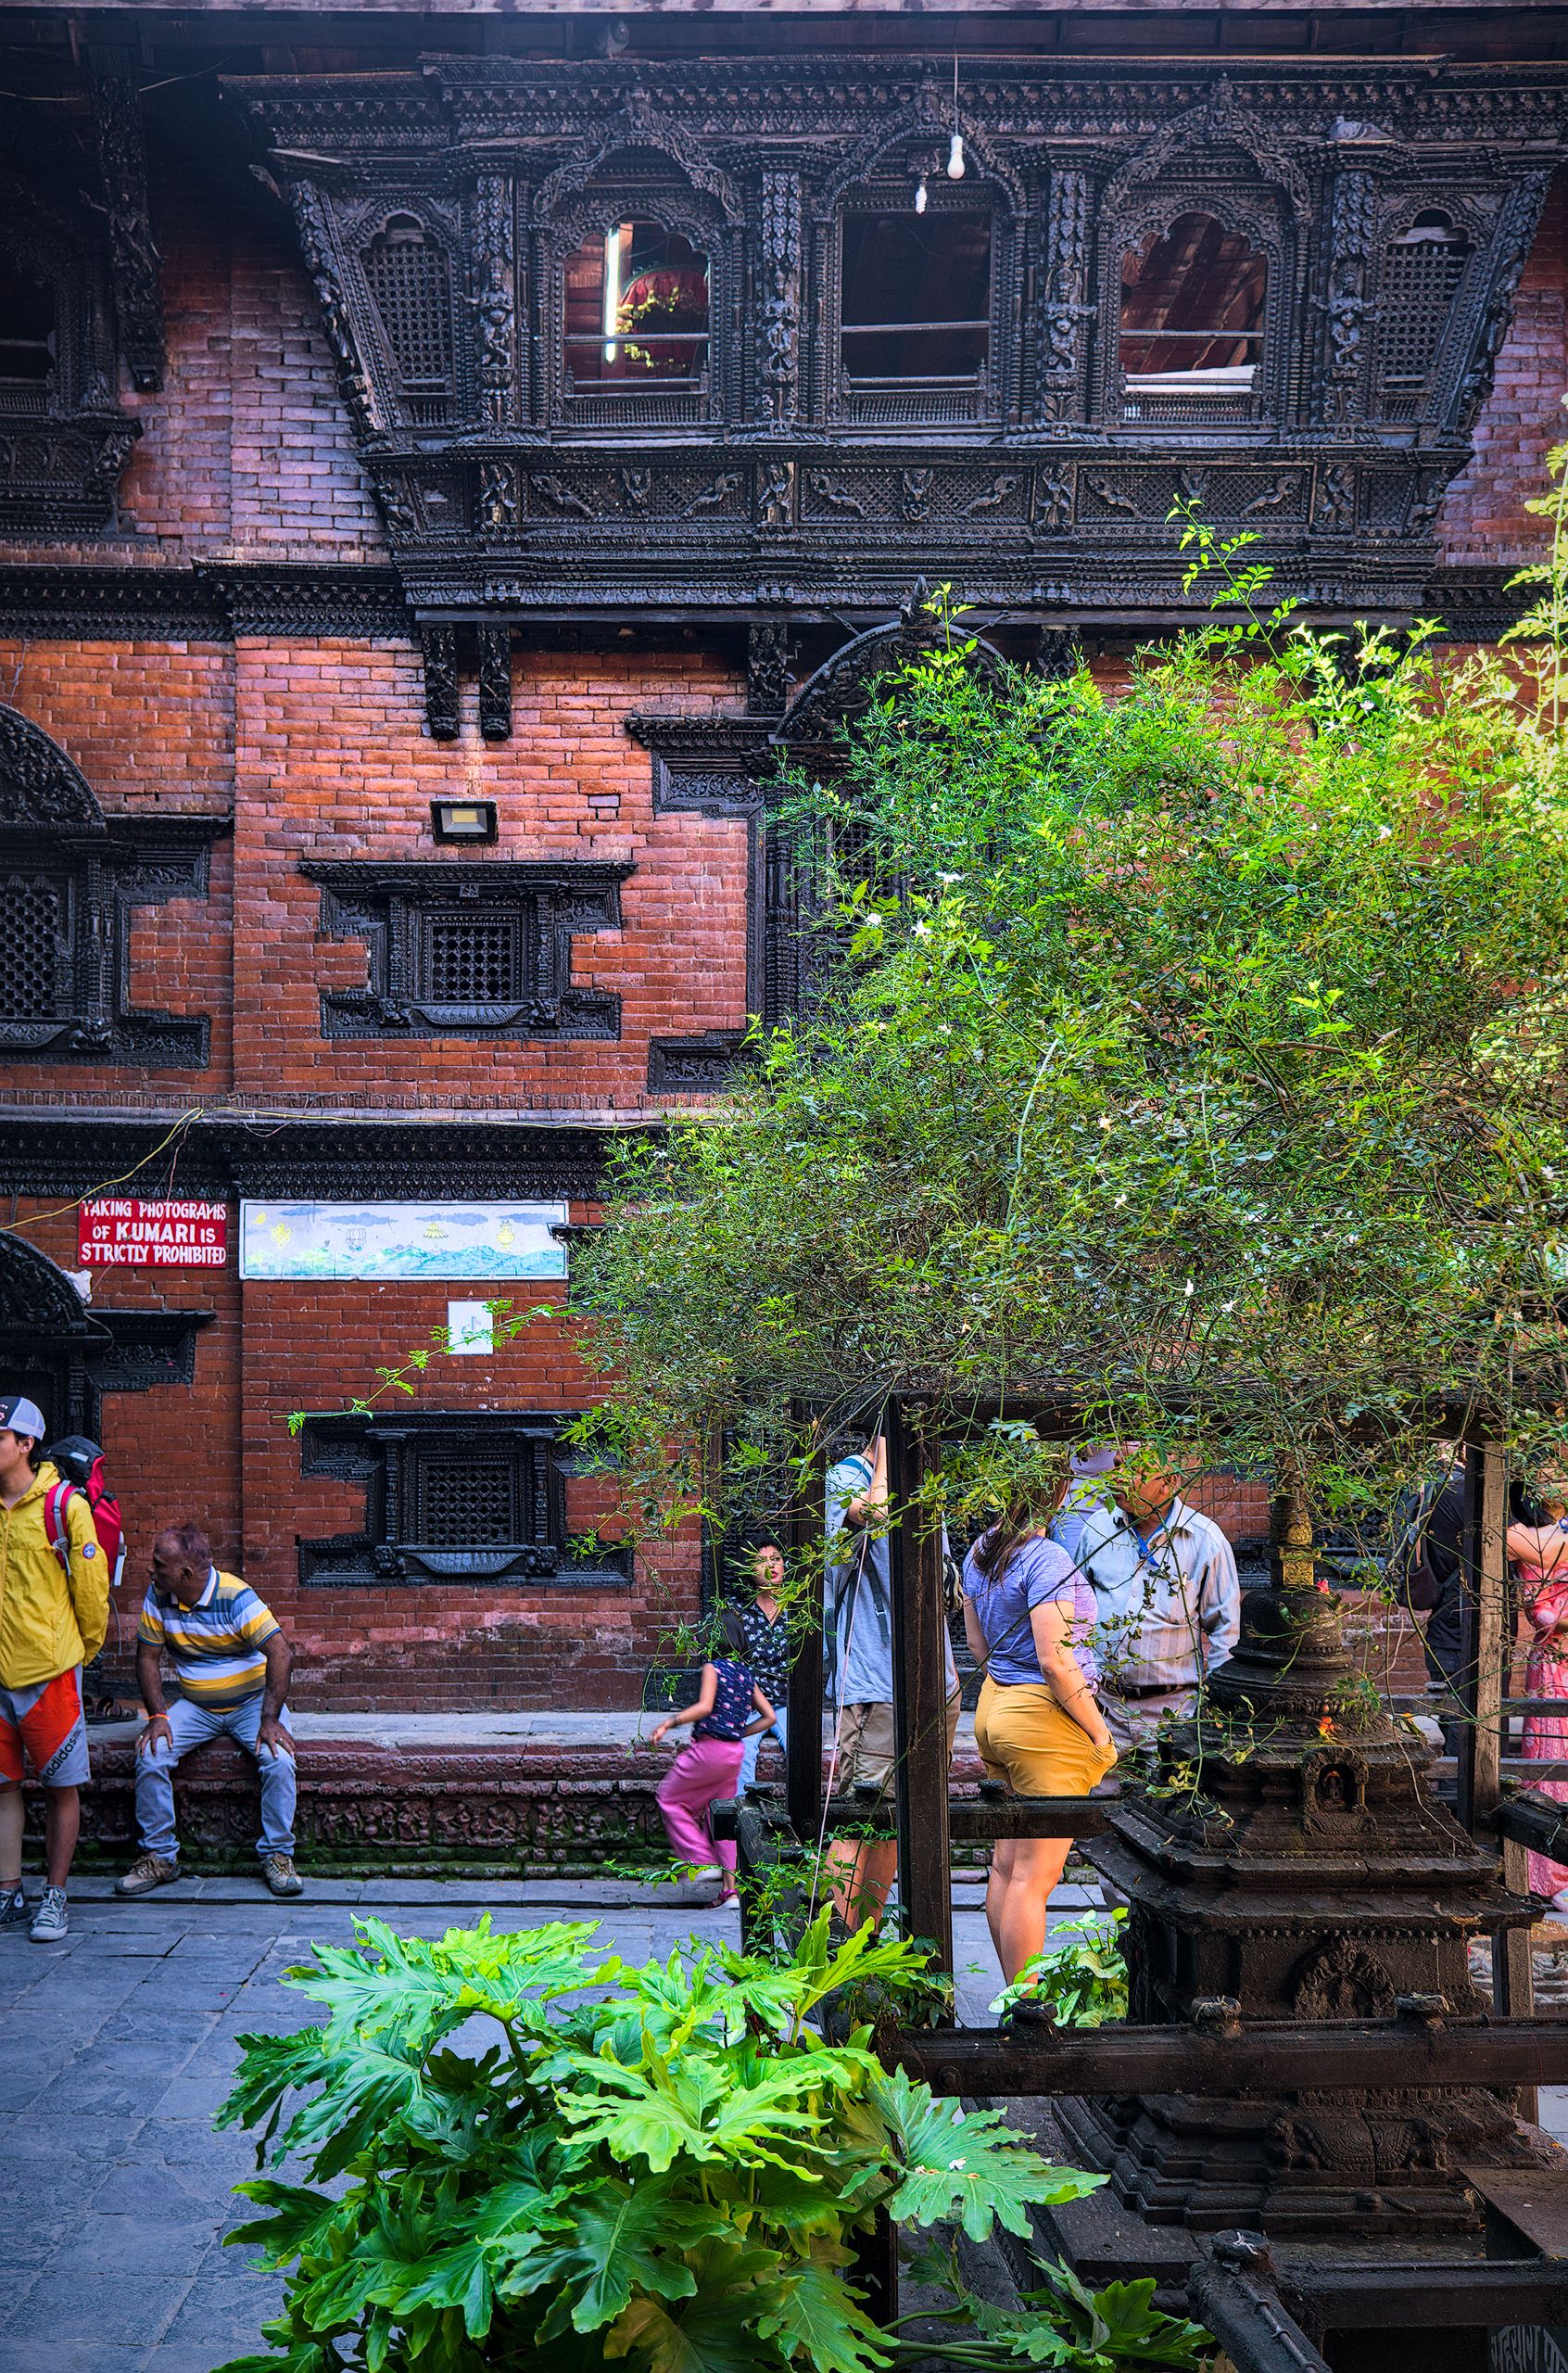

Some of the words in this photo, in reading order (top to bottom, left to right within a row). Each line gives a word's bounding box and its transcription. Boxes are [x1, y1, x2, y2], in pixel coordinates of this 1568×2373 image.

[82, 1200, 132, 1217] TAKING
[139, 1202, 227, 1221] PHOTOGRAPHS
[93, 1226, 111, 1240] OF
[117, 1222, 195, 1243] KUMARI
[82, 1243, 149, 1263] STRICTLY
[154, 1246, 226, 1264] PROHIBITED
[46, 1738, 76, 1777] adidas
